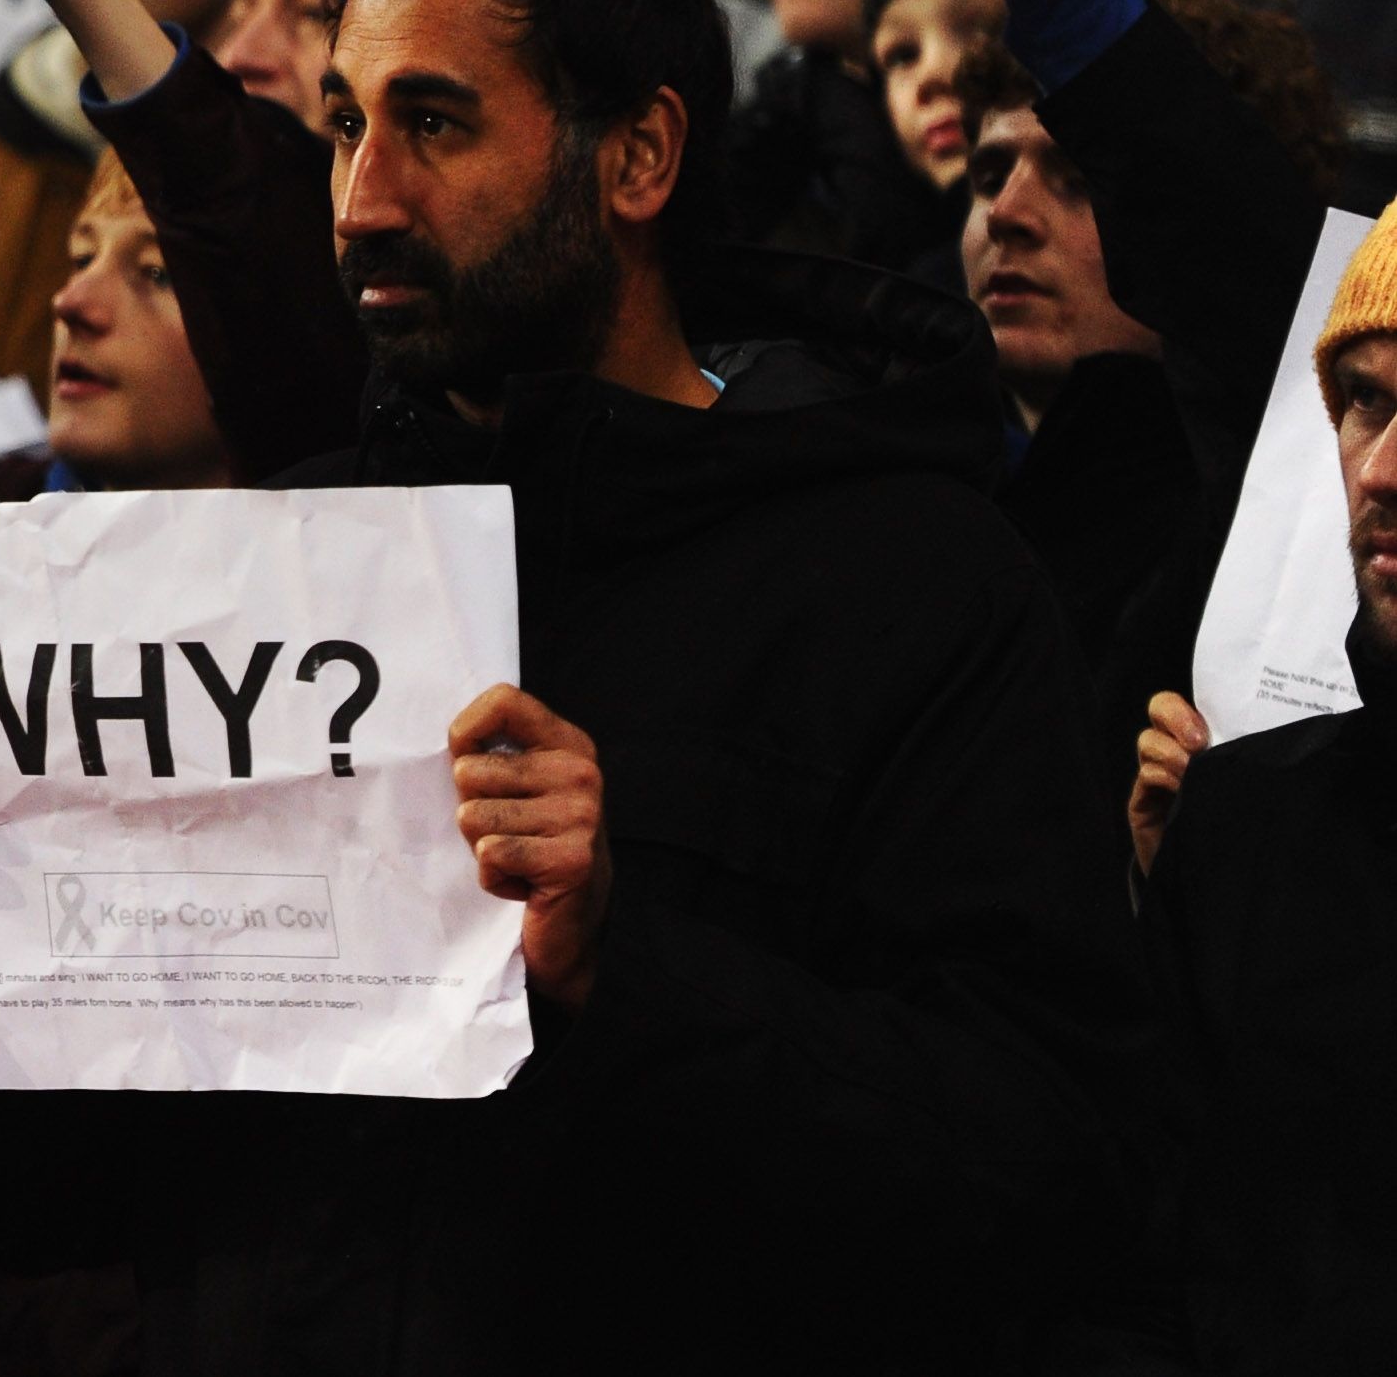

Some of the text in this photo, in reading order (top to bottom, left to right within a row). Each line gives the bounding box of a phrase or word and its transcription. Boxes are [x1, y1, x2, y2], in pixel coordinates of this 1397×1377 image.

[99, 902, 328, 934] Keep Cov in Cov
[5, 974, 37, 982] minutes
[39, 973, 55, 982] and
[87, 973, 113, 982] WANT
[117, 973, 130, 982] TO
[132, 973, 148, 982] GO
[192, 972, 221, 982] WANT
[225, 972, 238, 982] TO
[240, 972, 256, 982] GO
[291, 973, 318, 984] BACK
[320, 973, 334, 983] TO
[336, 974, 354, 984] THE
[392, 975, 412, 985] THE
[32, 999, 49, 1010] play
[51, 997, 63, 1007] 35
[163, 999, 196, 1007] means
[198, 997, 218, 1009] why
[219, 998, 235, 1007] has
[236, 998, 252, 1007] this
[254, 998, 276, 1008] been
[278, 998, 312, 1008] allowed
[314, 999, 323, 1008] to
